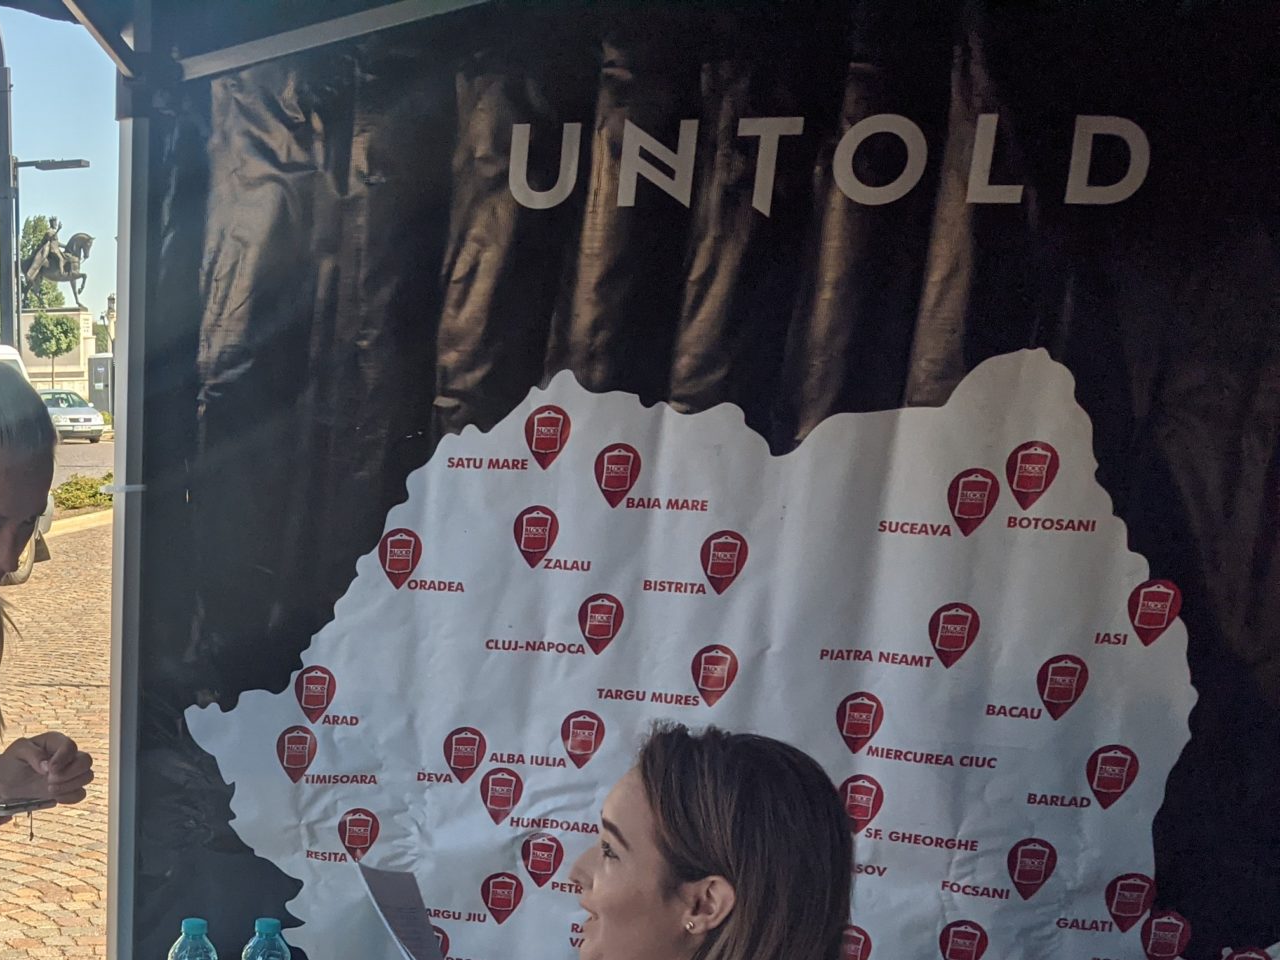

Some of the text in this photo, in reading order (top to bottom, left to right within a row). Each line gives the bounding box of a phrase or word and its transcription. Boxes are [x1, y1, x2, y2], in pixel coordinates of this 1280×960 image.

[507, 113, 1152, 217] UNTOLD
[447, 456, 529, 471] SATU MARE
[626, 497, 709, 512] BAIA MARE
[878, 520, 952, 537] SUCEAVA
[1007, 516, 1097, 532] BOTOSANI
[543, 558, 592, 572] ZALAU
[407, 579, 465, 593] ORADEA
[642, 579, 707, 595] BISTRITA
[485, 638, 586, 655] CLUJ-NAPOCA
[1094, 632, 1128, 646] IASI
[820, 648, 935, 668] PIATRA NEAMT
[597, 688, 700, 706] TARGU MURES
[985, 703, 1042, 720] BACAU
[322, 714, 359, 726] ARAD
[489, 752, 567, 768] ALBA IULIA
[866, 745, 998, 769] MIERCUREA CIUC
[304, 773, 378, 785] TIMISOARA
[417, 771, 453, 783] DEVA
[1026, 793, 1092, 809] BARLAD
[510, 816, 599, 834] HUNEDOARA
[865, 827, 979, 852] SF. GHEORGHE
[305, 849, 348, 863] RESITA
[855, 863, 887, 877] SOV
[551, 881, 584, 895] PETR
[940, 880, 1010, 900] FOCSANI
[425, 908, 487, 924] ARGU JIU
[1055, 917, 1113, 933] GALATI
